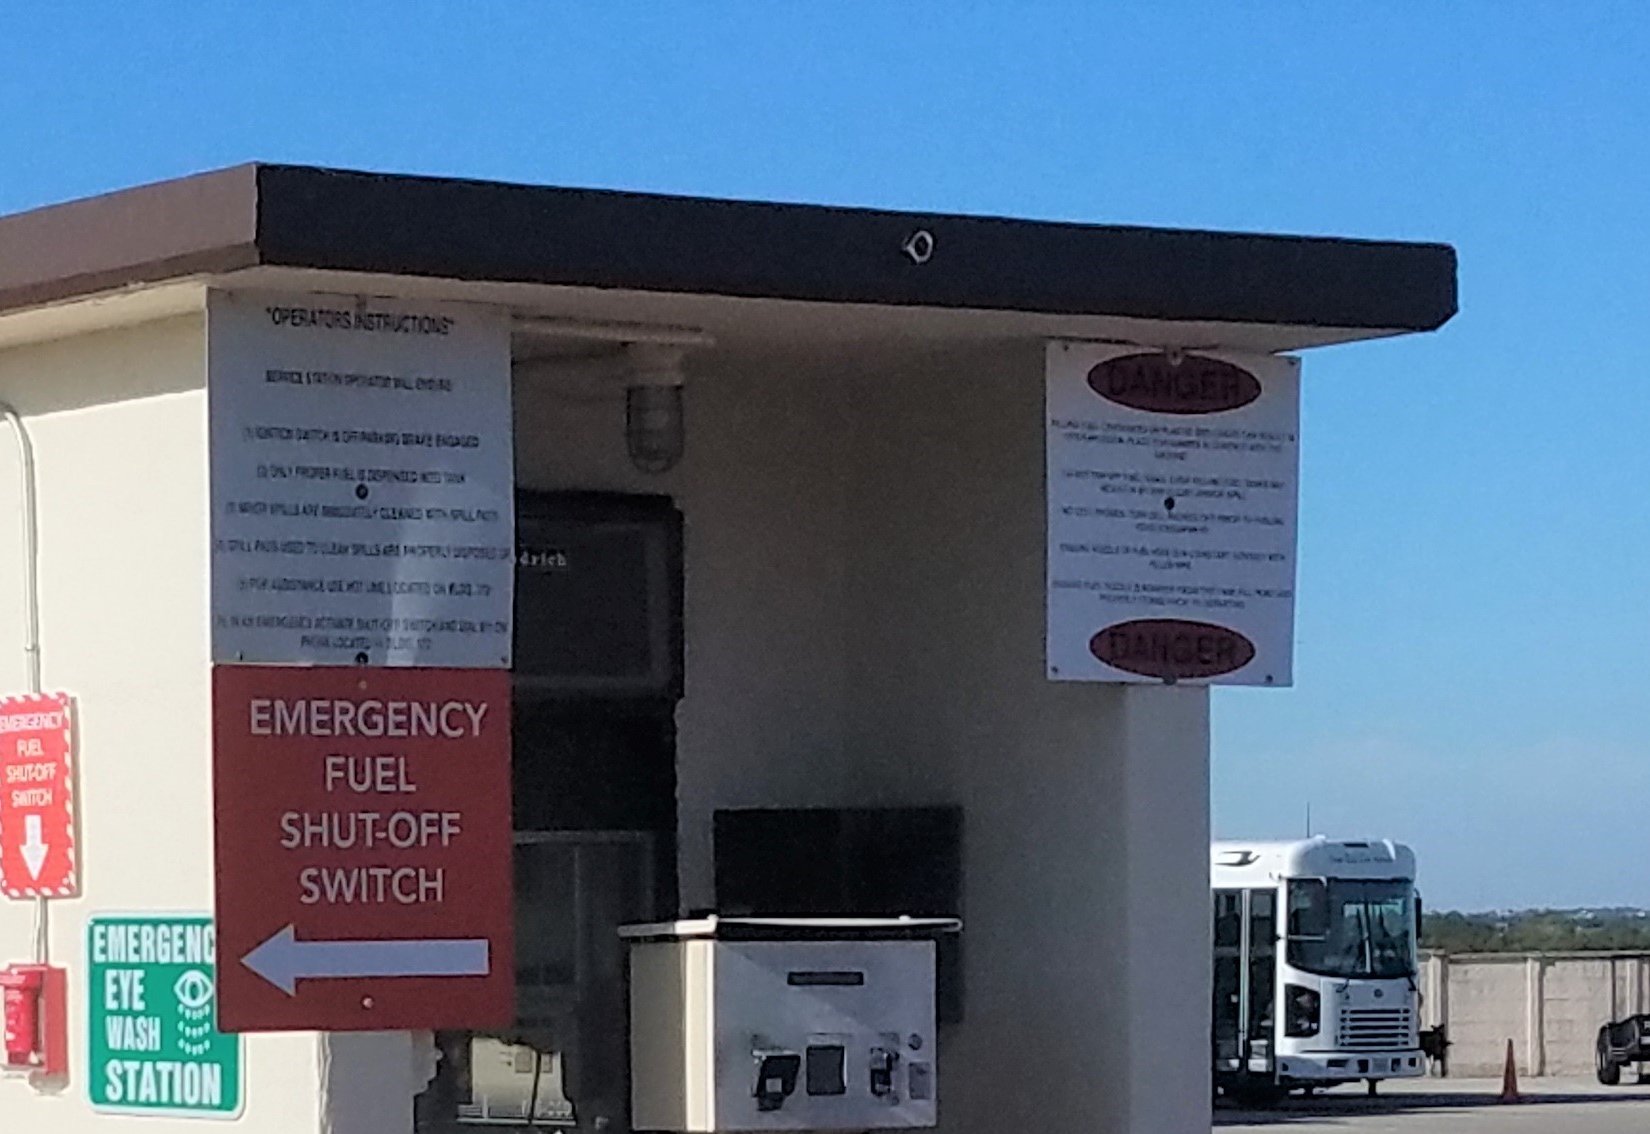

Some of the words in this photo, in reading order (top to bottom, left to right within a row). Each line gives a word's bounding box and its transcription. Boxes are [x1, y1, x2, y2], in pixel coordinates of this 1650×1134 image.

[250, 699, 488, 738] EMERGENCY
[17, 738, 45, 757] FUEL
[6, 761, 57, 783] SHUT-OFF
[325, 756, 416, 792] FUEL
[11, 788, 53, 808] SWITCH
[280, 811, 461, 848] SHUT-OFF
[300, 867, 444, 904] SWITCH
[93, 924, 214, 964] EMERGENC
[105, 969, 146, 1011] EYE
[105, 1015, 161, 1051] WASH
[105, 1059, 222, 1106] STATION
